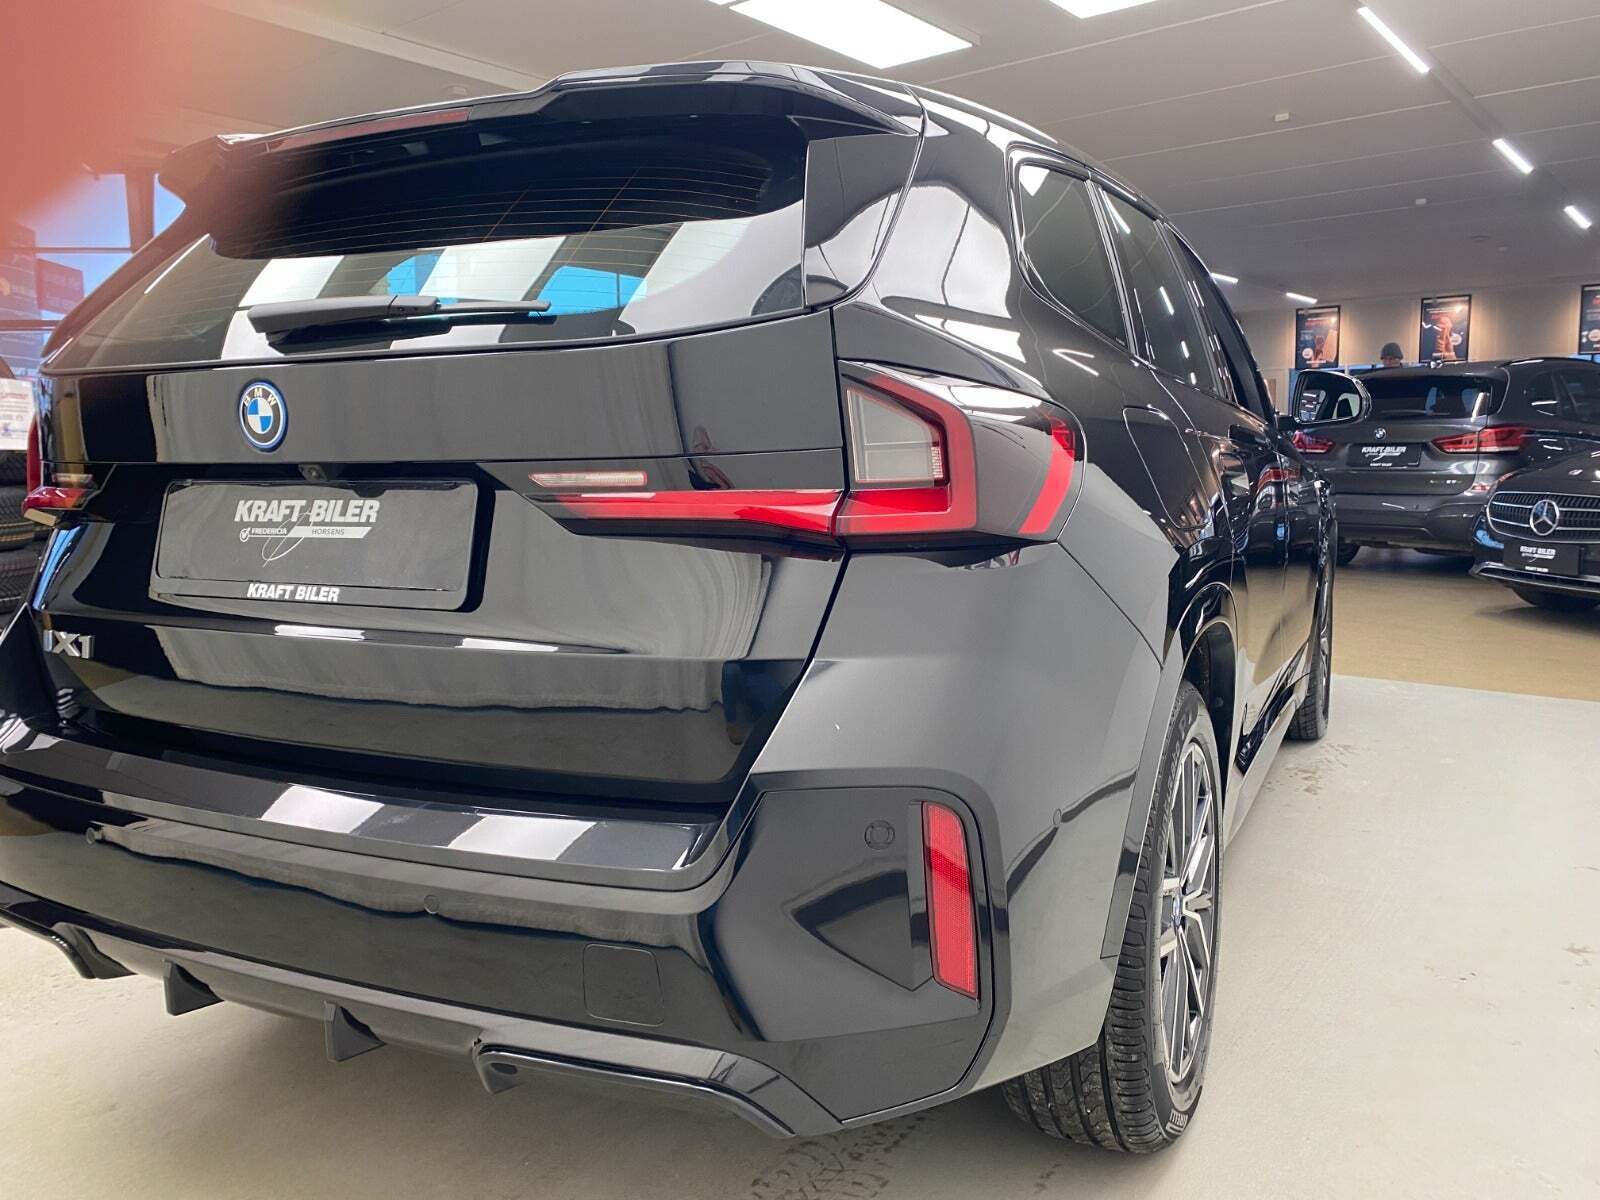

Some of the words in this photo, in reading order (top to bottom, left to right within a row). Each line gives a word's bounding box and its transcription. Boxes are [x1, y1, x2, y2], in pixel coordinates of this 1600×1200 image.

[243, 387, 277, 407] BMW
[234, 499, 306, 522] KRAFT
[309, 499, 380, 523] BILER
[311, 528, 345, 536] HORSENS
[246, 583, 294, 600] KRAFT
[295, 585, 340, 602] BILER
